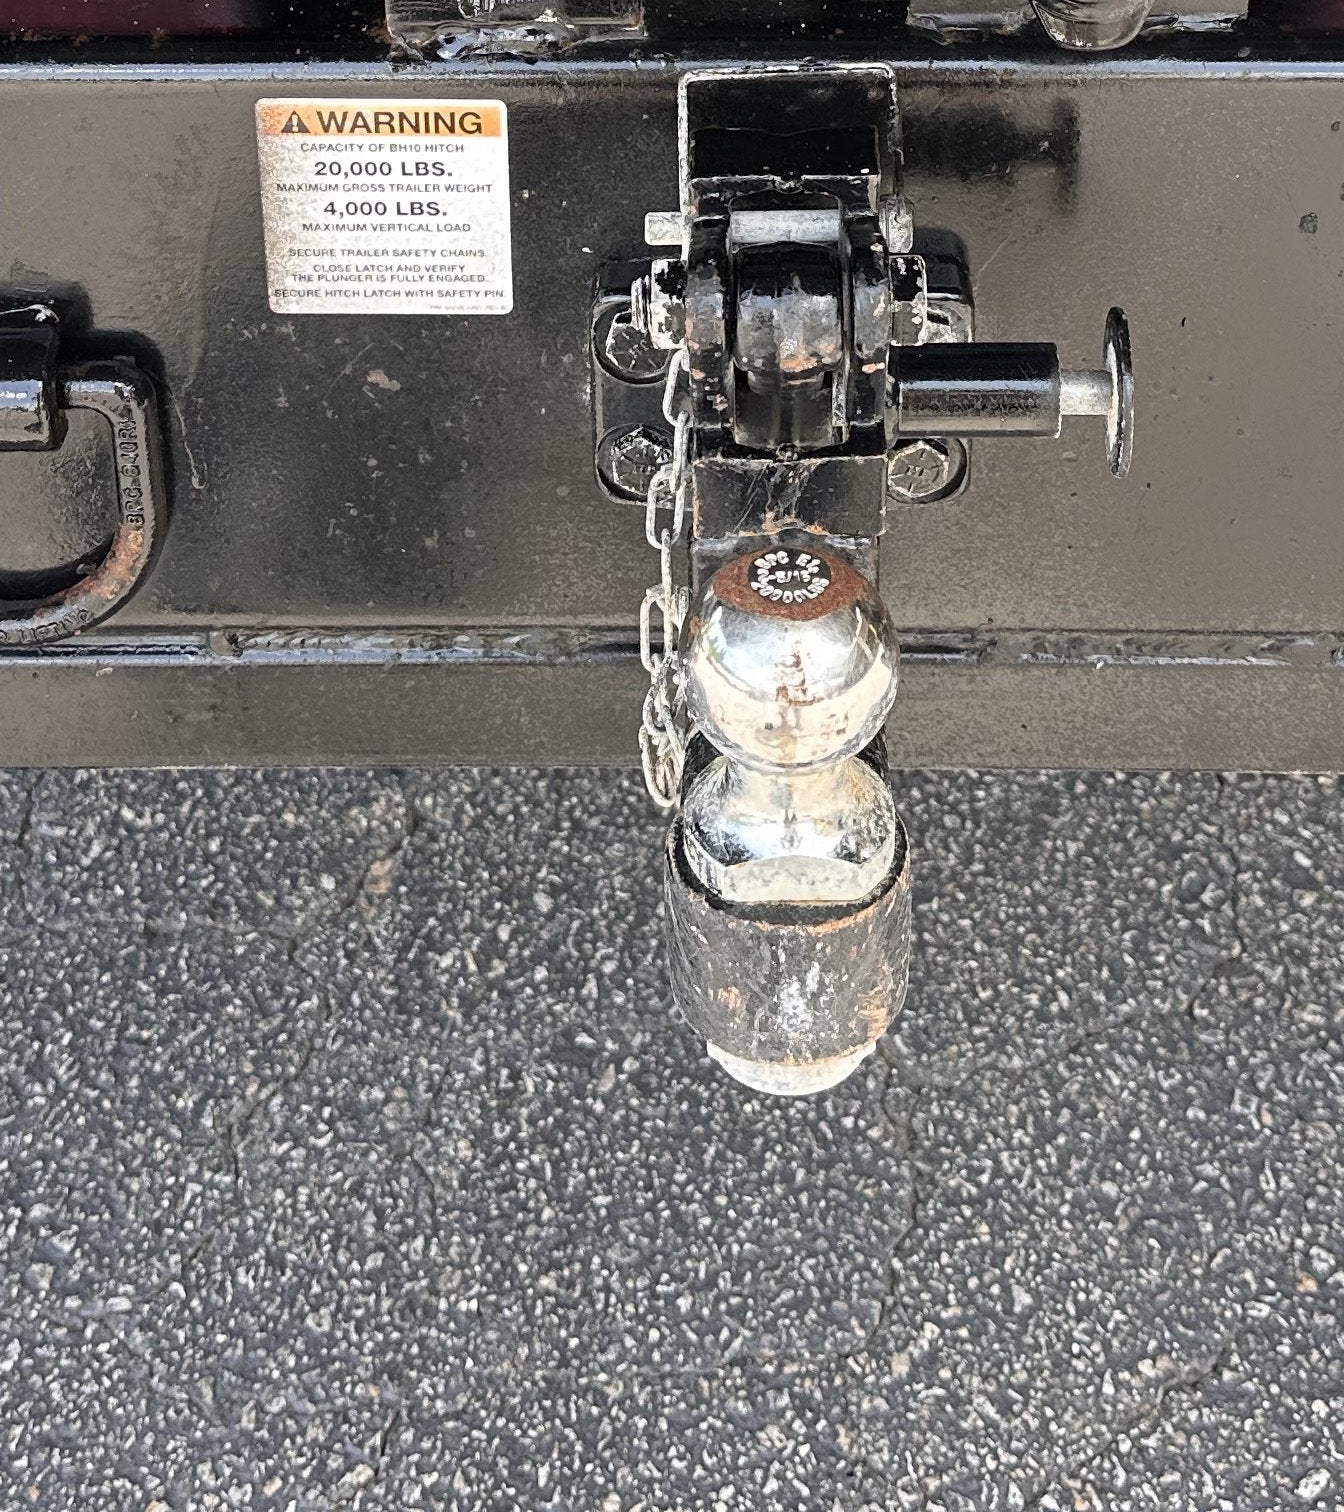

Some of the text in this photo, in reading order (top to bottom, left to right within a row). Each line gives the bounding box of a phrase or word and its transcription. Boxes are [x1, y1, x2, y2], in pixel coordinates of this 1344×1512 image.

[316, 111, 482, 134] WARNING
[300, 143, 364, 153] CAPACITY
[368, 143, 386, 153] OF
[425, 143, 464, 153] HITCH
[314, 161, 453, 178] 20,000 LBS.
[277, 183, 493, 193] MAXIMUM GROSS TRAILER WEIGHT
[323, 201, 448, 218] 4,000 LBS.
[302, 223, 471, 232] MAXIMUM VERTICAL LOAD
[289, 249, 336, 258] SECURE
[341, 249, 389, 258] TRAILER
[392, 249, 436, 258] SAFETY
[313, 264, 466, 273] CLOSE LATCH AND VERIFY
[292, 274, 314, 283] THE
[317, 274, 373, 283] PLUNGER
[376, 274, 386, 283] IS
[390, 274, 425, 283] FULLY
[274, 289, 322, 298] SECURE
[325, 289, 360, 298] HITCH
[363, 289, 401, 298] LATCH
[405, 289, 434, 298] WITH
[437, 289, 481, 298] SAFETY
